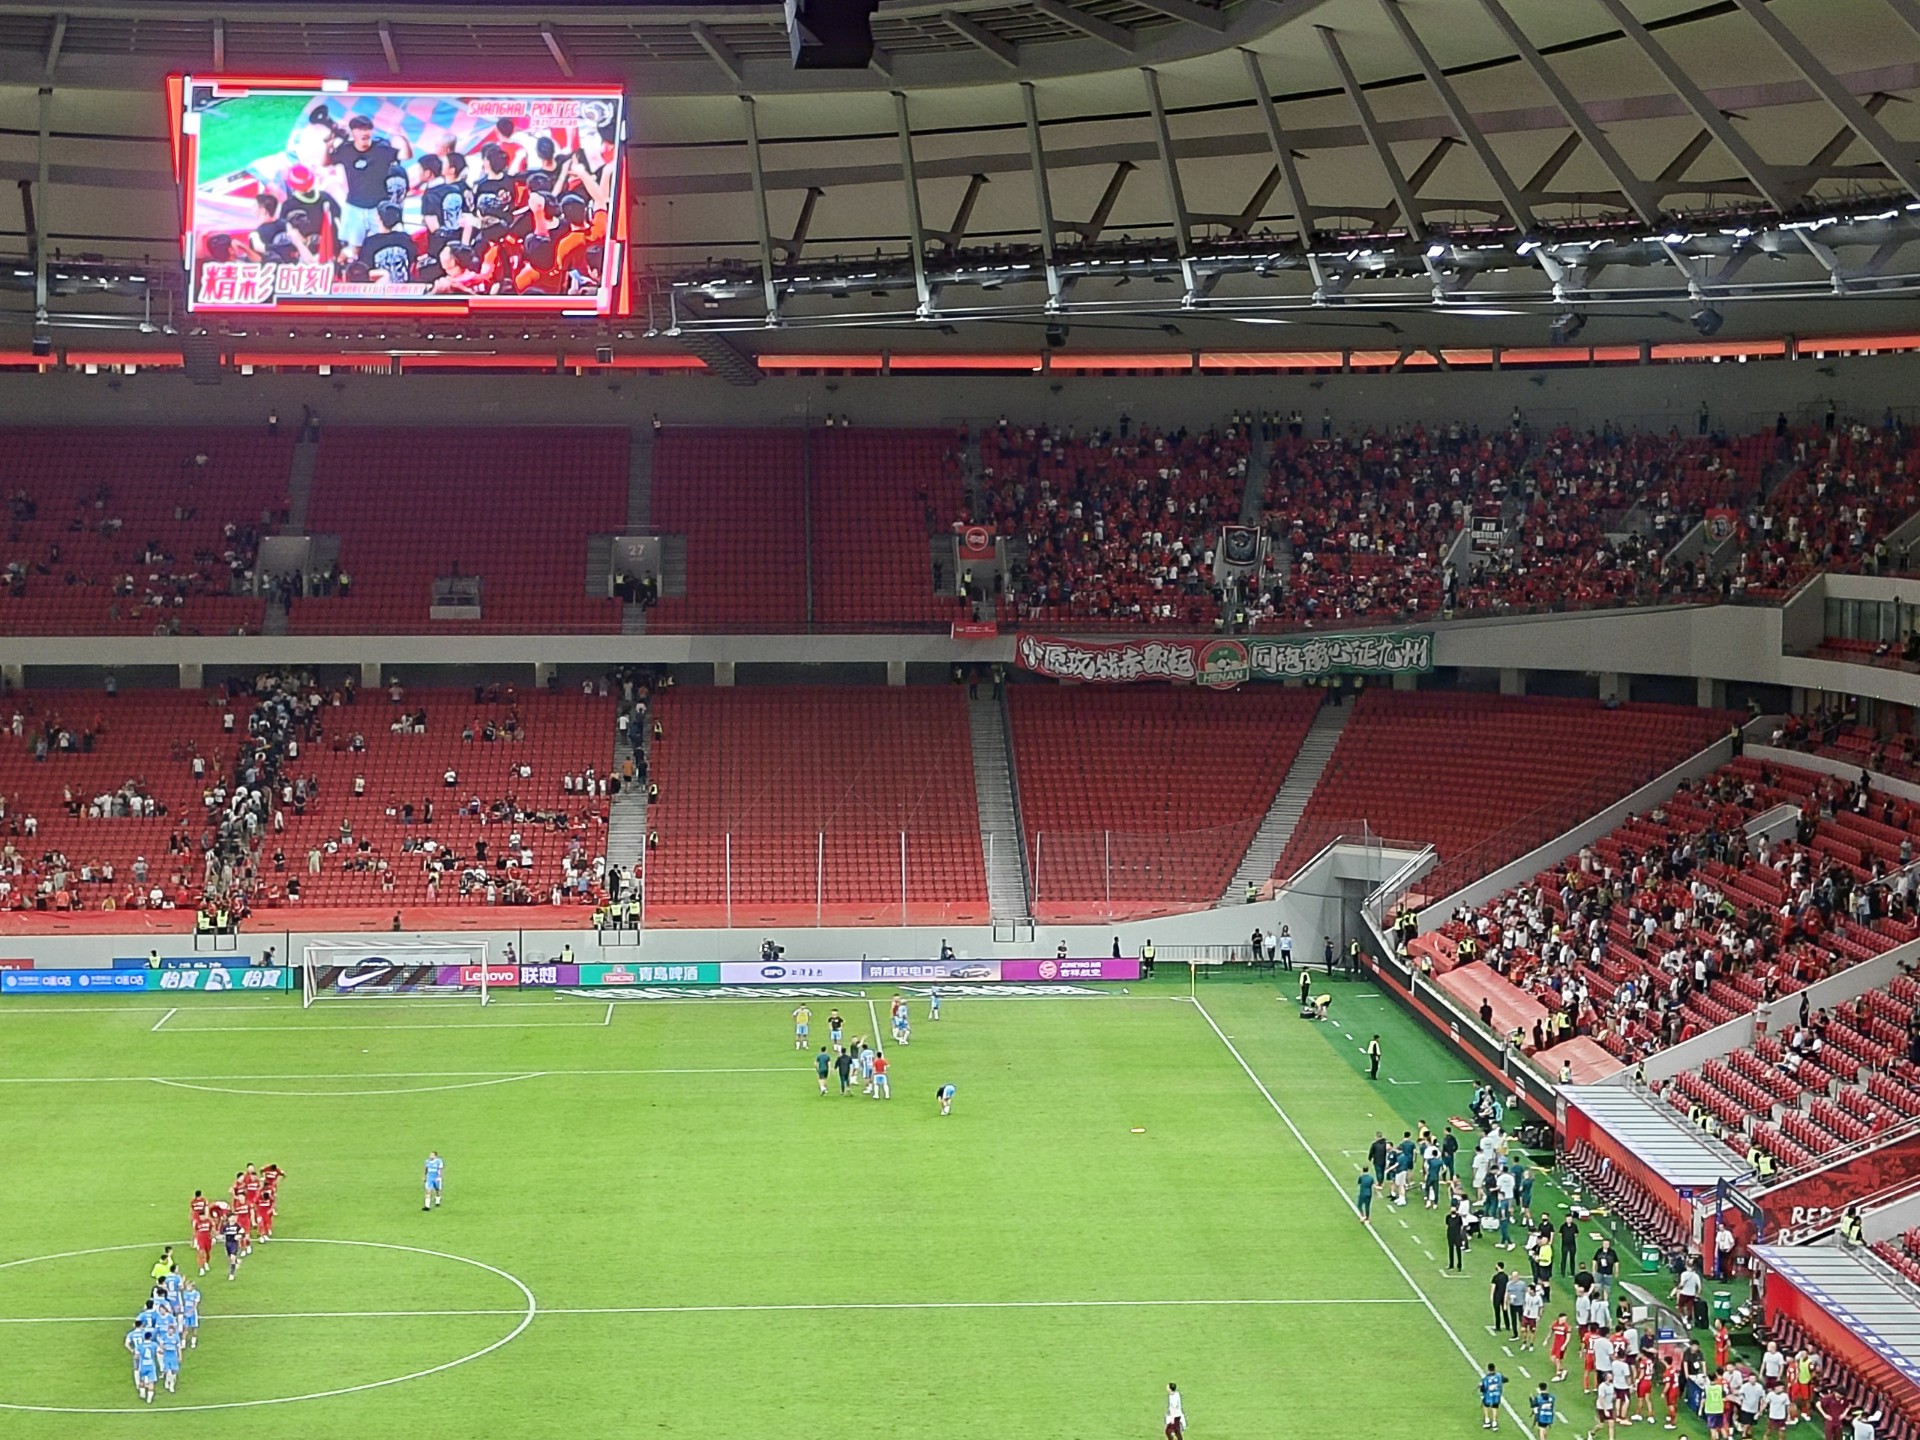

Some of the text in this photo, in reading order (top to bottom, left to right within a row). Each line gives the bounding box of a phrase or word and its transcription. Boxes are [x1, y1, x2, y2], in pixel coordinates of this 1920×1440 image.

[468, 101, 579, 116] SHANGHAI PORT FC
[201, 264, 331, 300] 精彩时刻
[628, 544, 645, 556] 27
[1203, 670, 1243, 683] HENAN
[520, 966, 557, 984] 联想
